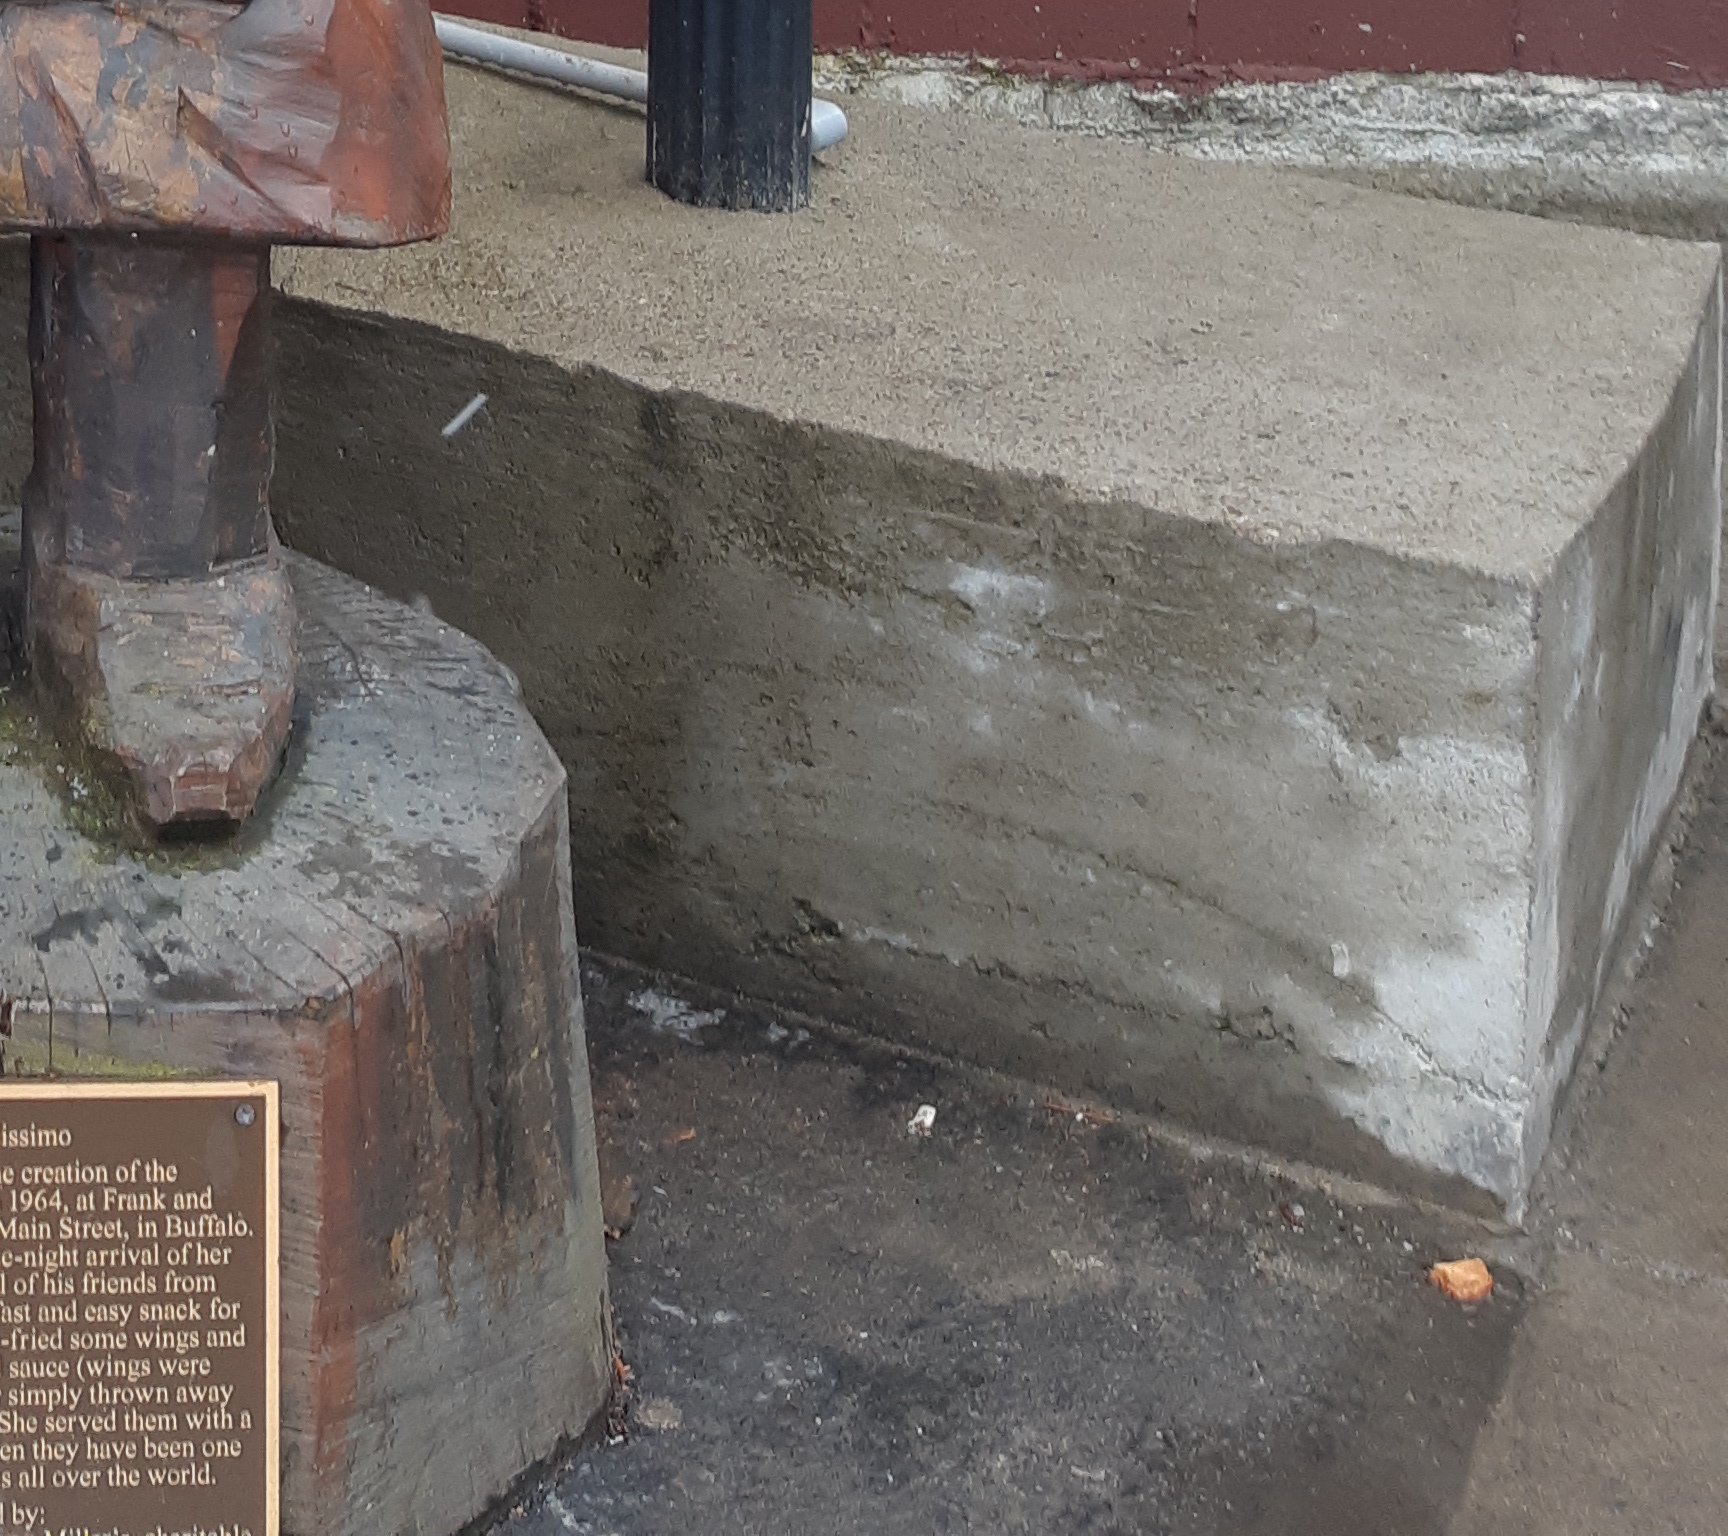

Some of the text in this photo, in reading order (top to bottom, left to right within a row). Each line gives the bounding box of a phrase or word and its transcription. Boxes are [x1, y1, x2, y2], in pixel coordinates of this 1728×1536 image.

[21, 1158, 109, 1185] creation
[115, 1158, 142, 1184] of
[144, 1157, 178, 1183] the
[10, 1188, 69, 1215] 1964,
[76, 1189, 96, 1212] at
[103, 1186, 167, 1212] Frank
[173, 1185, 213, 1211] and
[59, 1216, 130, 1242] Street,
[137, 1214, 158, 1239] in
[165, 1212, 254, 1238] Buffalo.
[86, 1241, 160, 1267] arrival
[166, 1241, 193, 1266] of
[196, 1240, 232, 1266] her
[13, 1271, 40, 1296] of
[43, 1269, 75, 1296] his
[82, 1269, 157, 1295] friends
[164, 1268, 217, 1294] from
[38, 1298, 77, 1324] and
[84, 1304, 133, 1326] easy
[139, 1297, 202, 1322] snack
[210, 1295, 241, 1321] for
[70, 1331, 128, 1351] some
[134, 1323, 200, 1352] wings
[206, 1322, 246, 1348] and
[9, 1359, 70, 1379] sauce
[76, 1352, 151, 1383] (wings
[158, 1356, 211, 1378] were
[8, 1379, 83, 1411] simply
[89, 1378, 169, 1405] thrown
[176, 1384, 234, 1410] away
[44, 1406, 117, 1434] served
[124, 1405, 178, 1432] them
[185, 1404, 233, 1430] with
[240, 1410, 252, 1430] a
[32, 1434, 80, 1466] they
[86, 1436, 137, 1460] have
[144, 1435, 195, 1460] been
[201, 1439, 242, 1458] one
[18, 1464, 45, 1489] all
[52, 1469, 102, 1488] over
[107, 1463, 140, 1488] the
[147, 1461, 217, 1486] world.
[11, 1500, 45, 1530] by:
